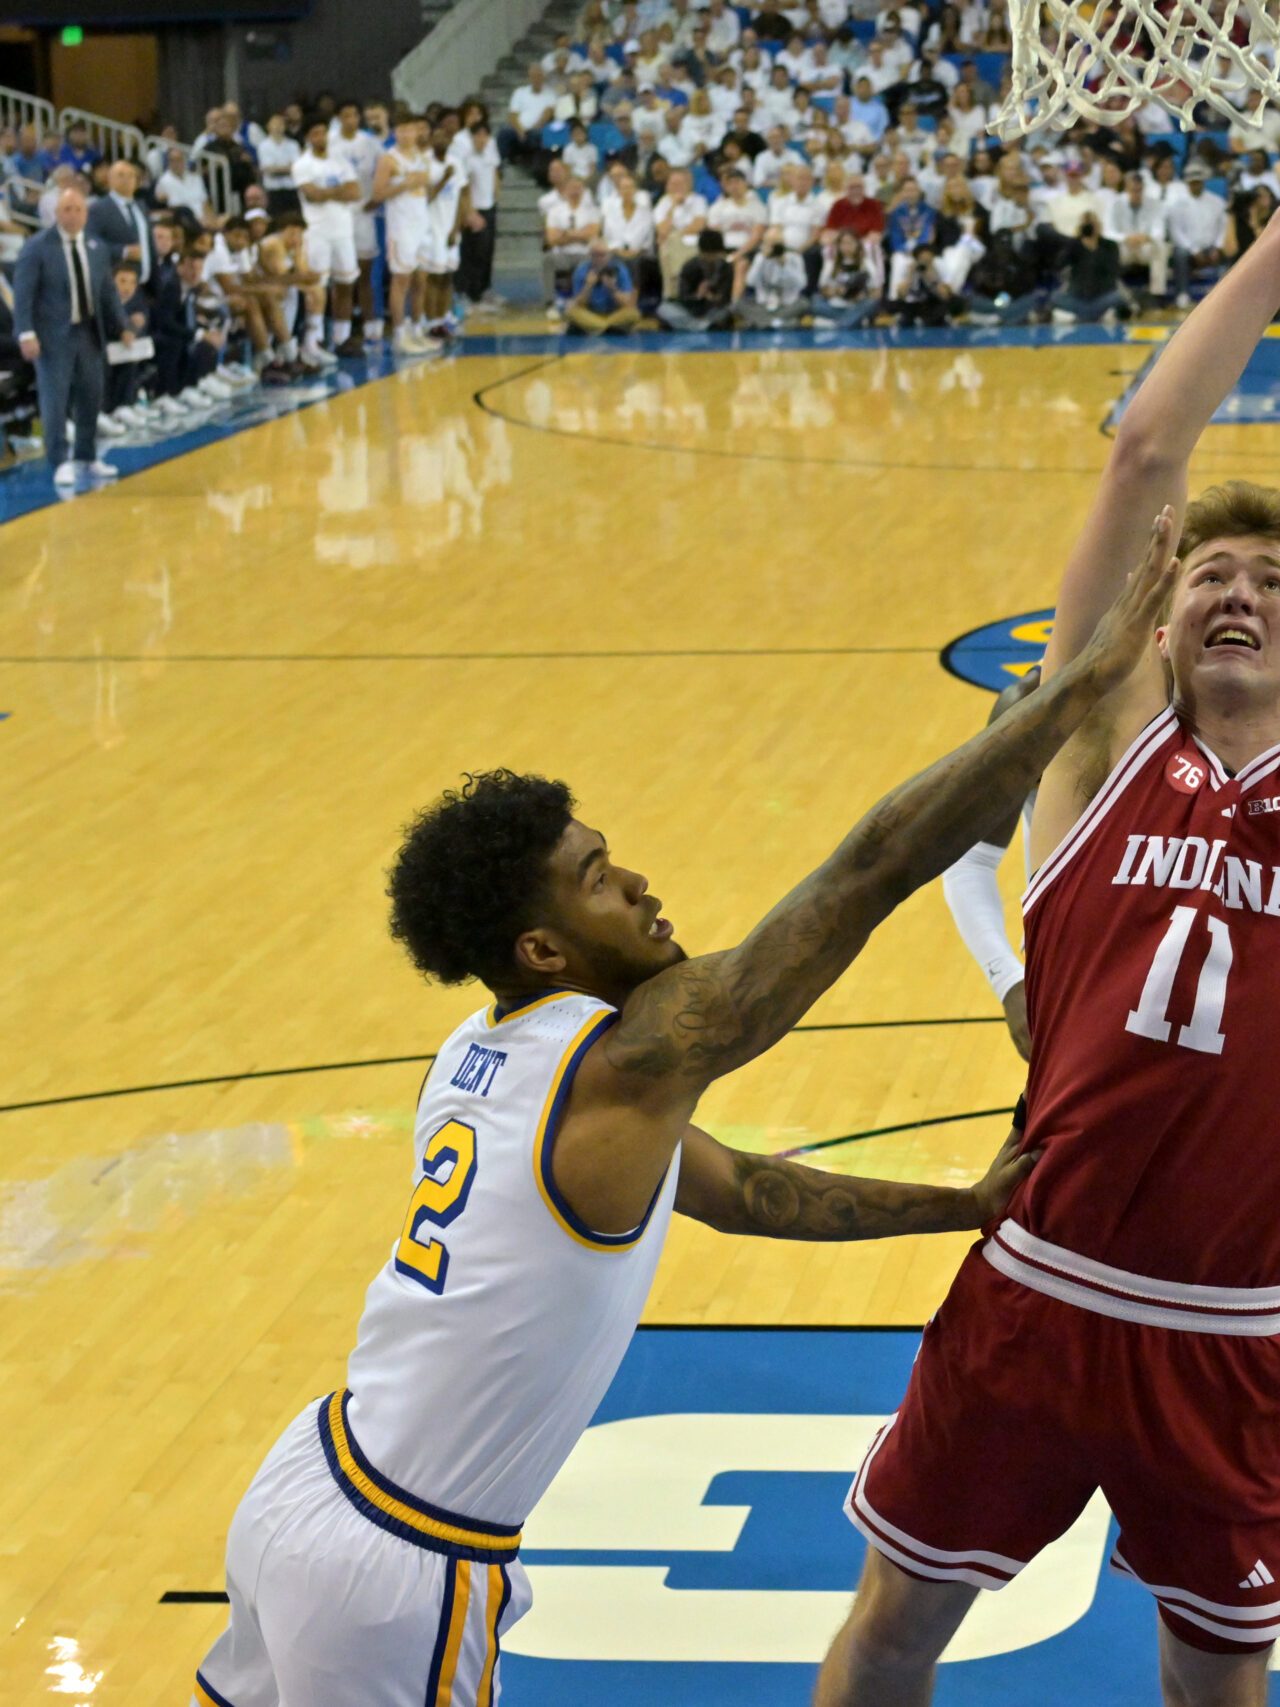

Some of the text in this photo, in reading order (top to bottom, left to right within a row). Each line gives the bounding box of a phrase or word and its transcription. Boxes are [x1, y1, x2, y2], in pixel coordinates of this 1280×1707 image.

[1170, 752, 1205, 790] '76
[1125, 904, 1234, 1056] 11
[450, 1042, 508, 1098] DENT
[395, 1117, 478, 1296] 2
